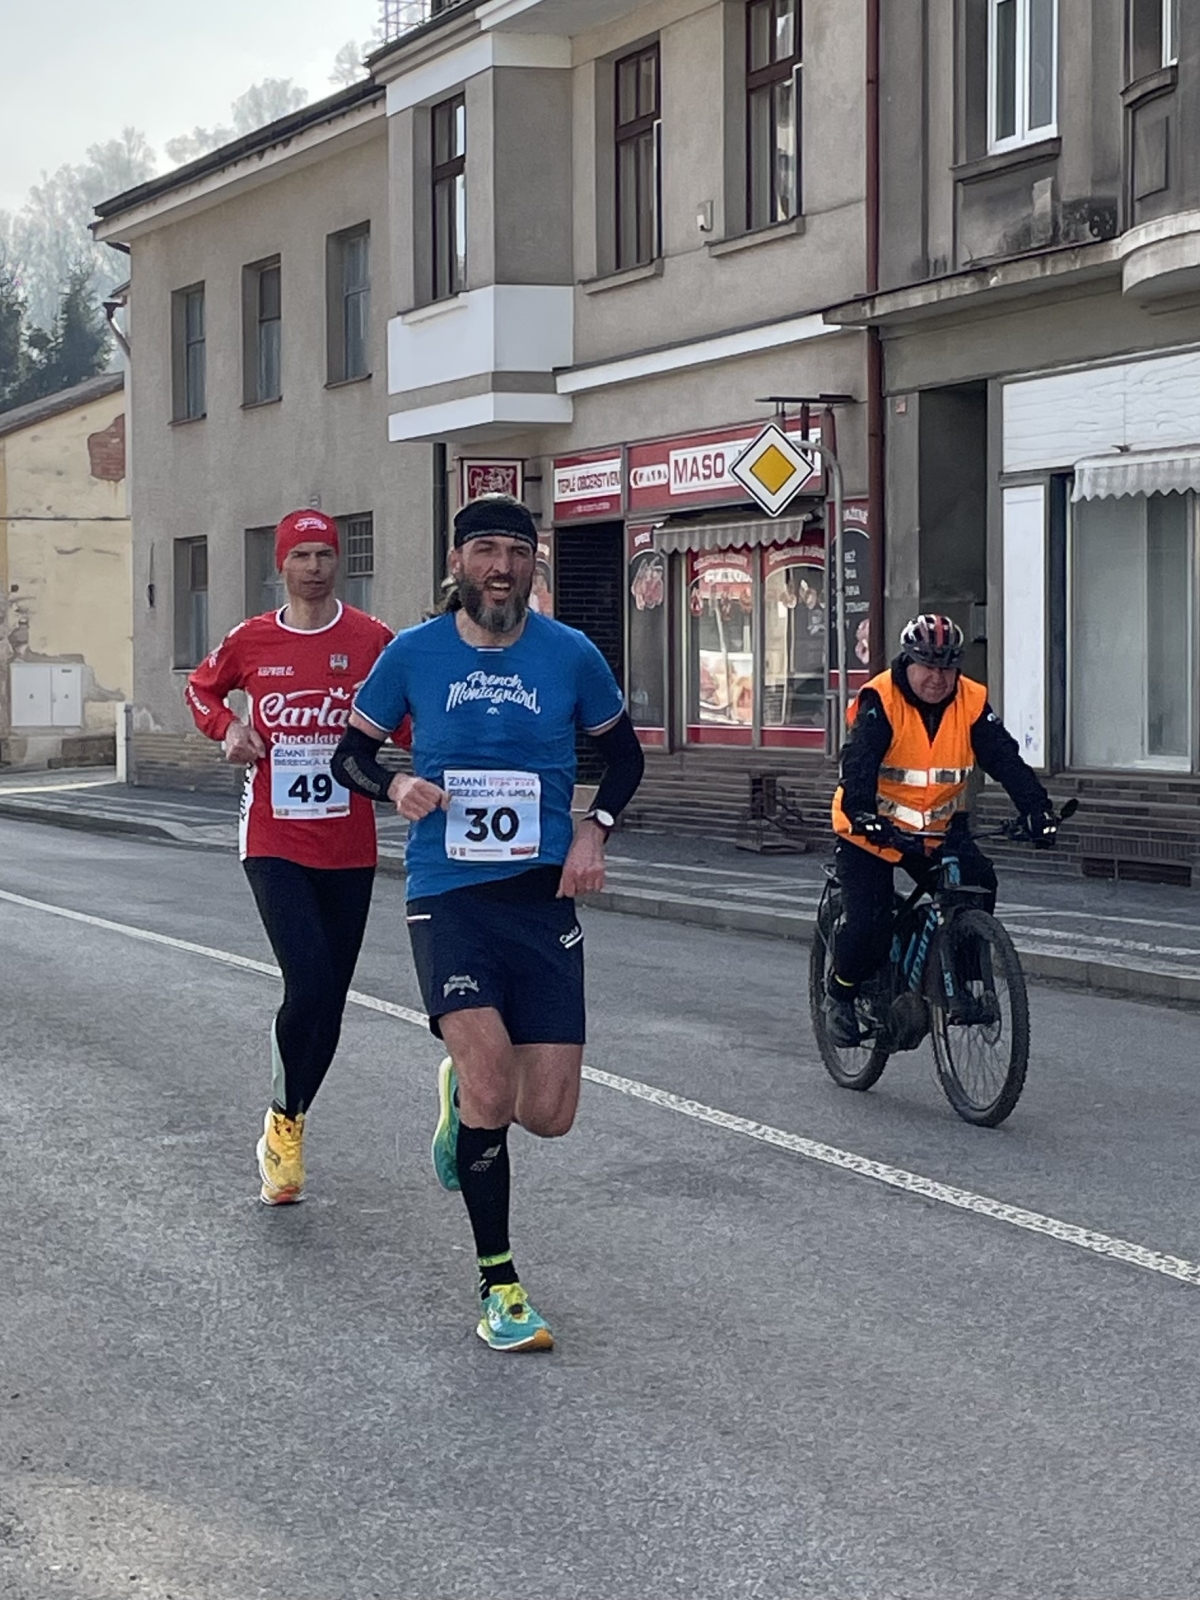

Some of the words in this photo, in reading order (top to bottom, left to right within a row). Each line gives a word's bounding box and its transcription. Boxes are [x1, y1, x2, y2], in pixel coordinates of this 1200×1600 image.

[673, 452, 726, 485] MASO
[466, 670, 523, 690] French
[258, 690, 350, 728] Carla
[445, 681, 541, 715] Montagnard
[288, 773, 333, 803] 49
[448, 775, 487, 787] ZIMNÍ
[464, 806, 520, 843] 30
